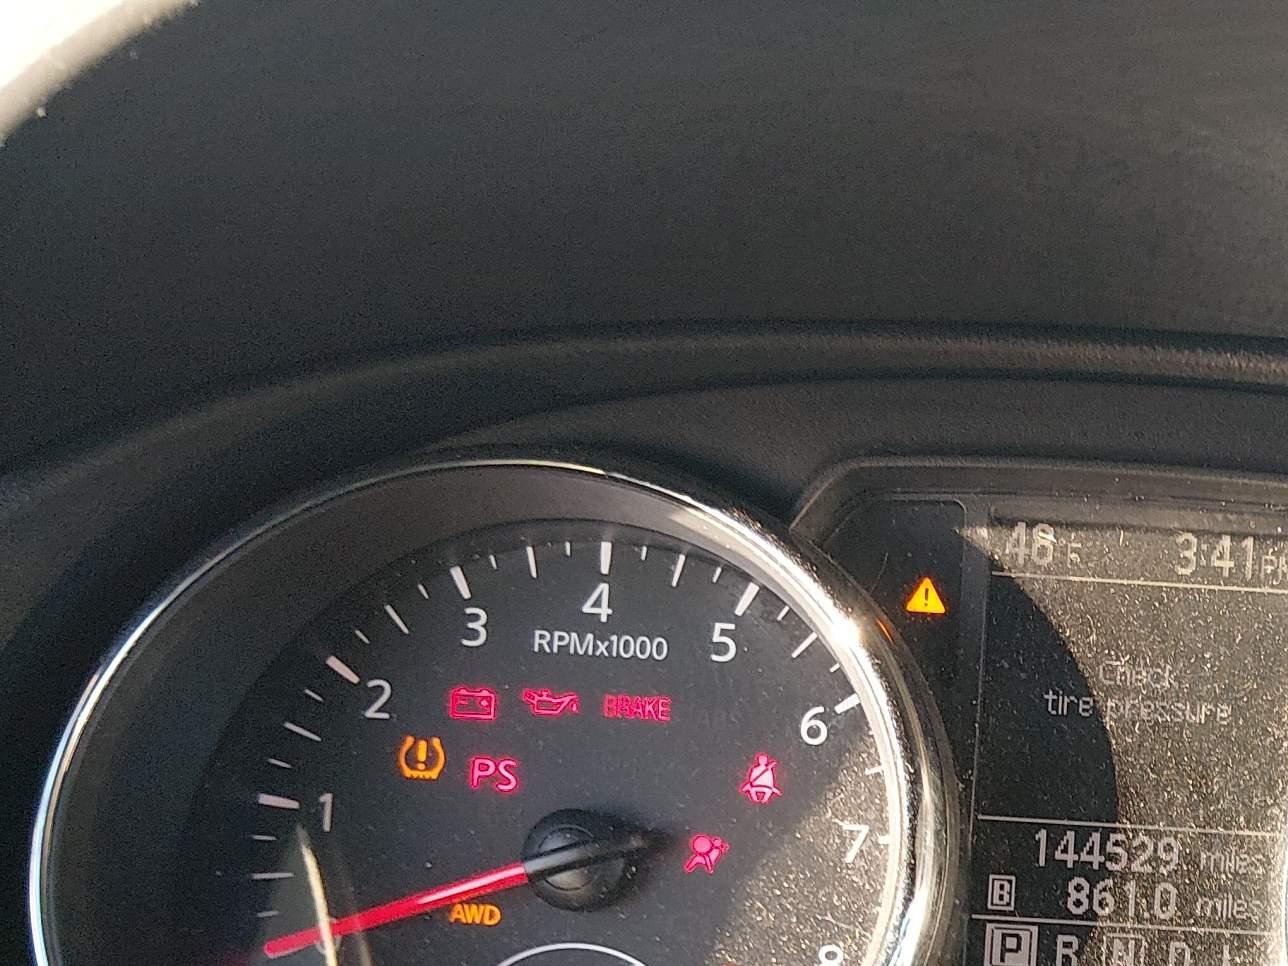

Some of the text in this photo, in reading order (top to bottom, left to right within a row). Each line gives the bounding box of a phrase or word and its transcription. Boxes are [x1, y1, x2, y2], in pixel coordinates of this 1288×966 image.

[1175, 532, 1253, 580] 3:41
[581, 582, 613, 622] 4
[461, 607, 488, 647] 3
[533, 629, 668, 661] RPMx1000
[710, 622, 737, 662] 5
[364, 679, 392, 720] 2
[603, 693, 672, 722] BRAKE
[1044, 690, 1094, 717] tire
[800, 706, 828, 746] 6
[470, 757, 519, 792] PS
[319, 792, 333, 833] 1
[841, 823, 870, 863] 7
[1035, 828, 1264, 875] 144529 miles
[450, 902, 501, 927] AWD
[993, 876, 1262, 922] B 861.0 miles
[1000, 931, 1024, 964] P
